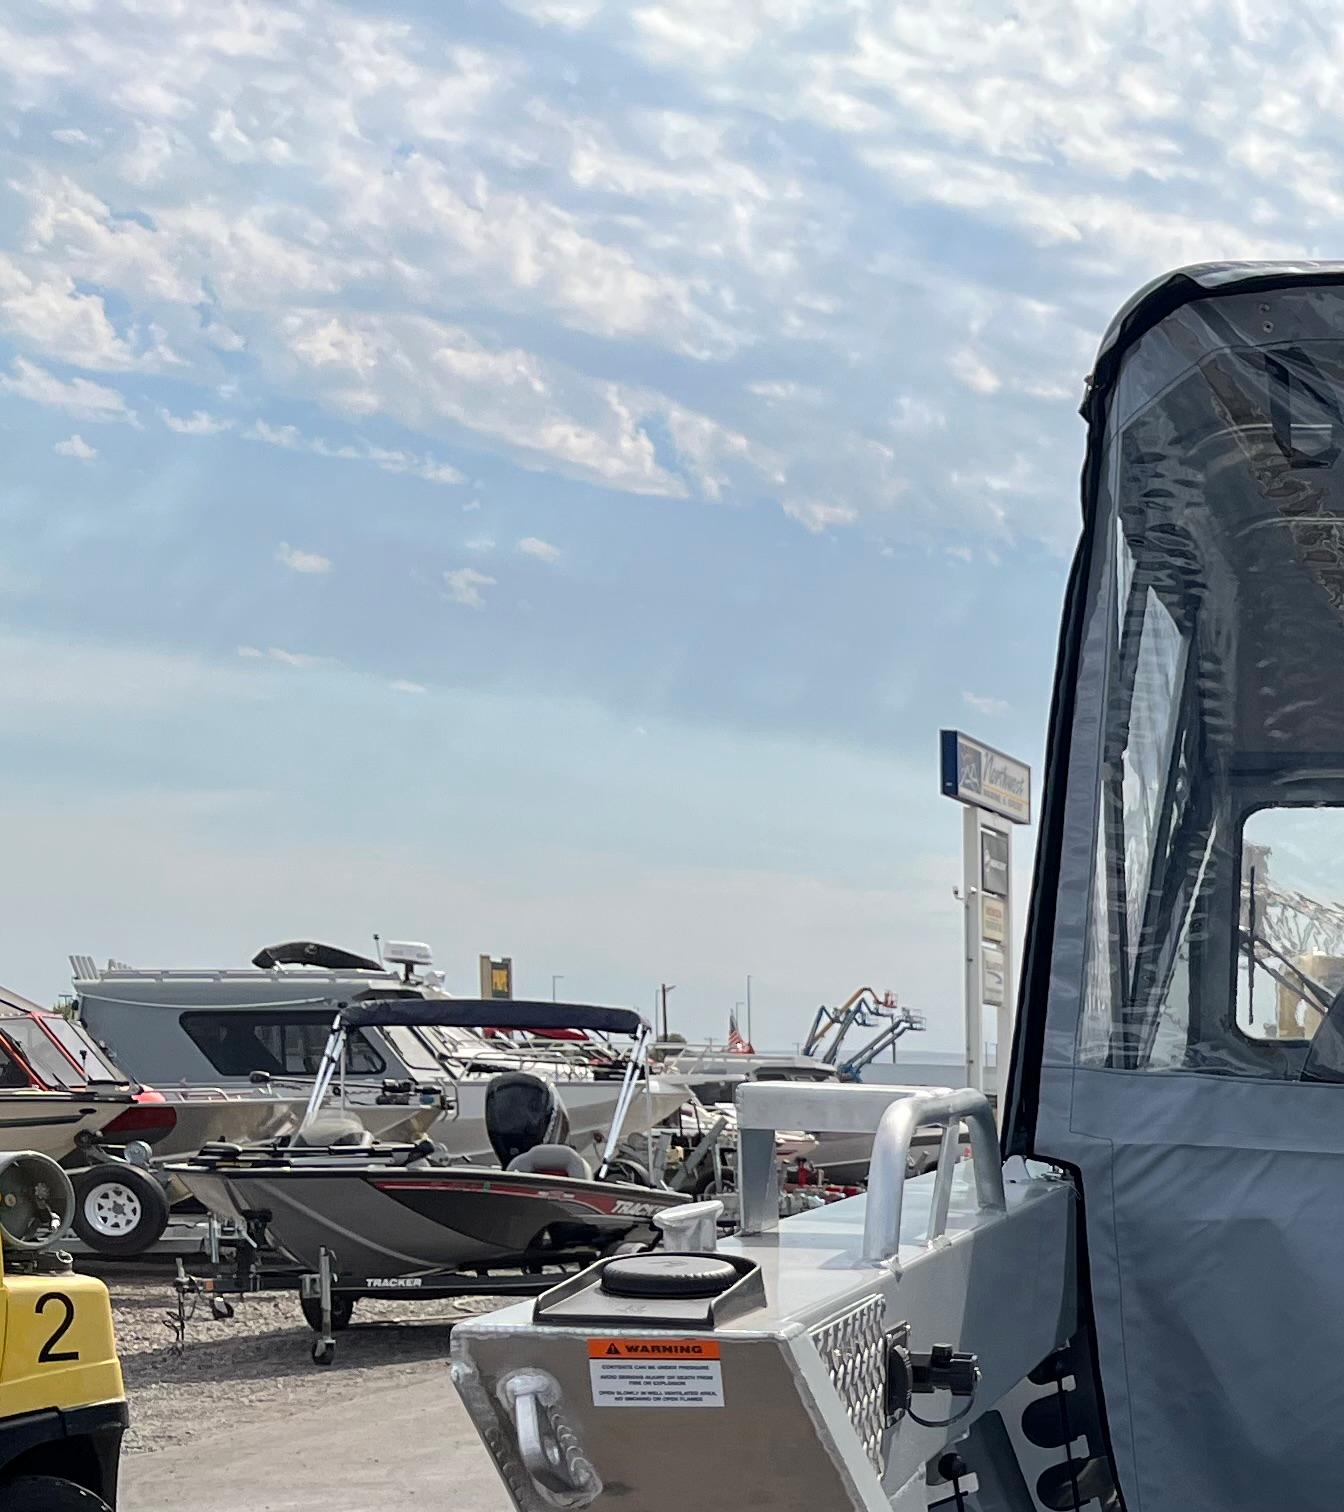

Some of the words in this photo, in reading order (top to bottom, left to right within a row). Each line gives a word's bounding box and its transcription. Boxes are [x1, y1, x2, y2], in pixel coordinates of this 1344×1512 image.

[366, 1278, 422, 1288] TRACKER
[35, 1291, 79, 1363] 2
[625, 1345, 703, 1354] WARNING
